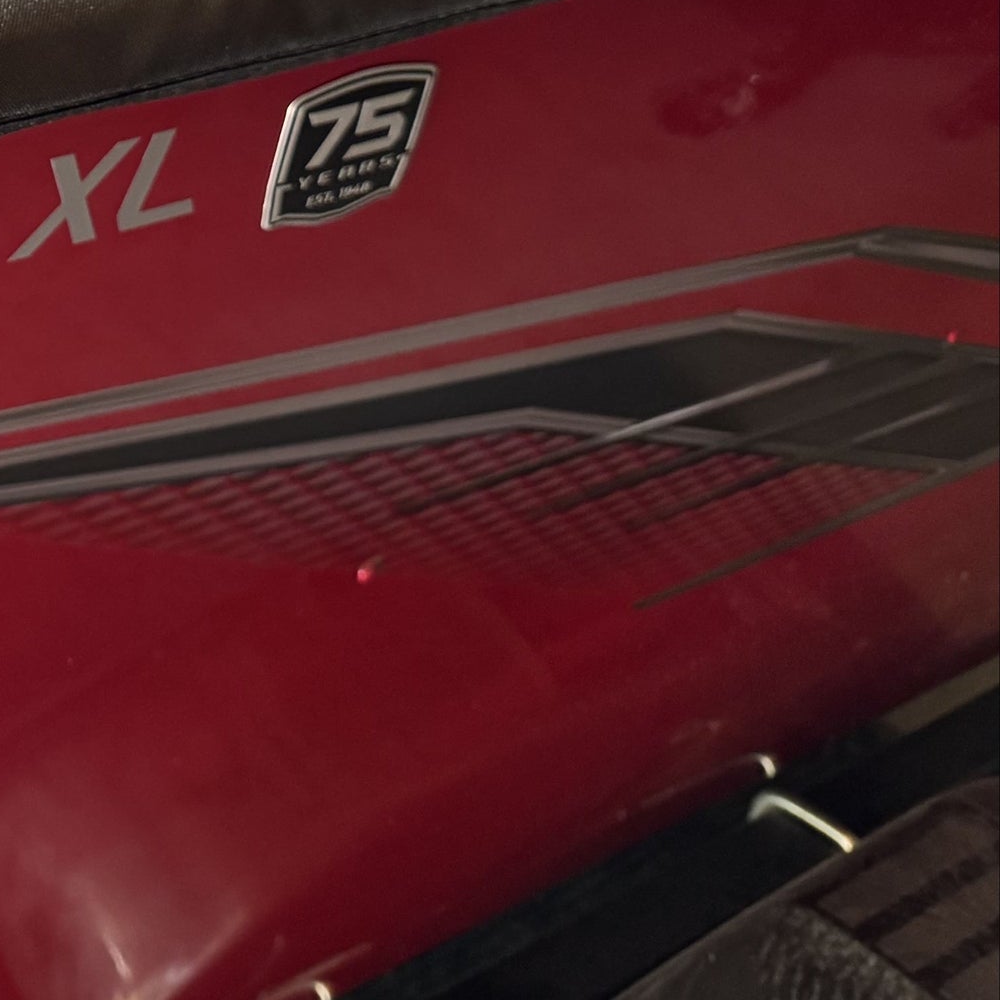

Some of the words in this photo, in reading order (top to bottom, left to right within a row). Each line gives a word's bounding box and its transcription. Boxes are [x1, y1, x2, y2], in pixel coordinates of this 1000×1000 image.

[304, 87, 416, 171] 75
[6, 127, 194, 262] XL
[299, 153, 396, 191] YEARS
